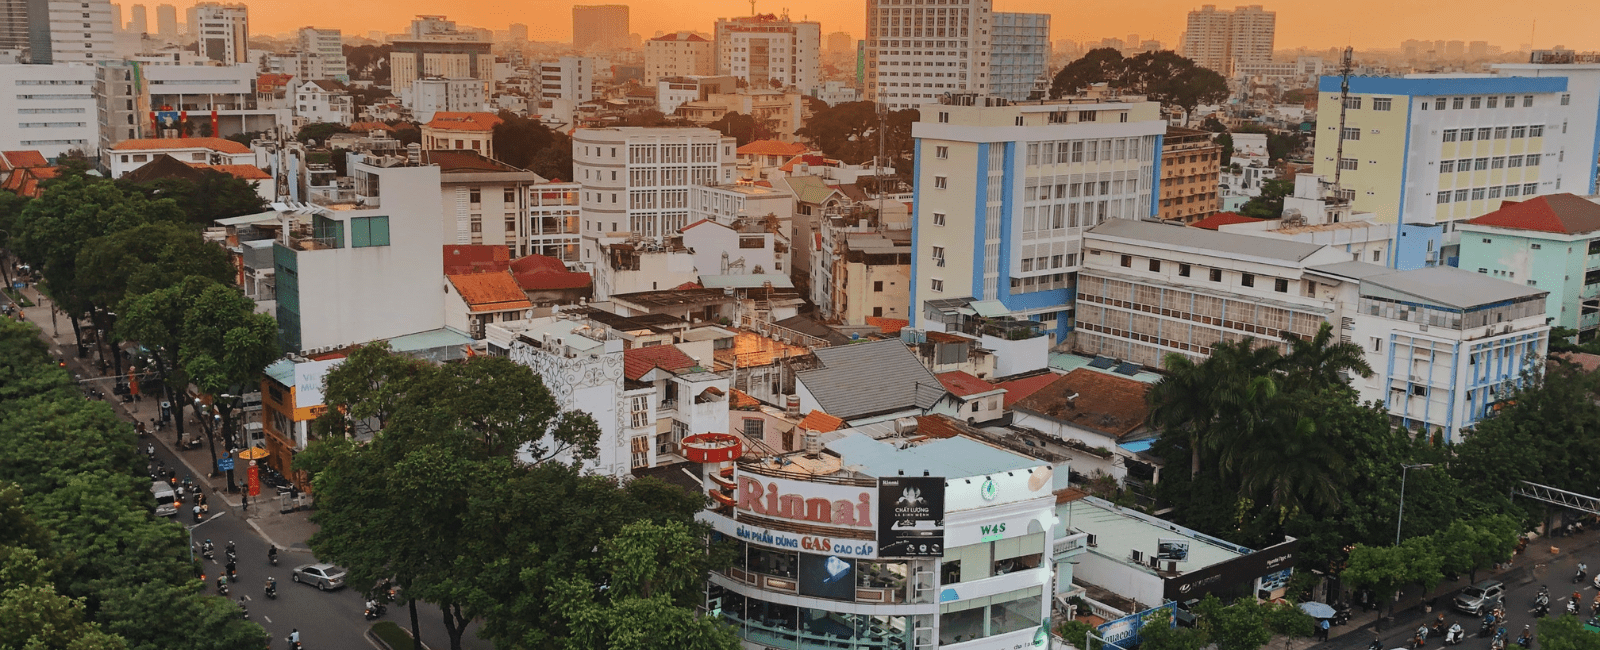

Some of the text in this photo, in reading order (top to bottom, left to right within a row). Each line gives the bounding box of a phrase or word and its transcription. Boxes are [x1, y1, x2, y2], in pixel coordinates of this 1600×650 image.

[737, 475, 873, 527] Rinnai
[981, 522, 1006, 535] W4S
[751, 530, 774, 544] PHẨM
[775, 535, 798, 548] DÙNG
[801, 536, 831, 552] GAS
[834, 544, 852, 554] CAO
[855, 543, 874, 556] CẤP
